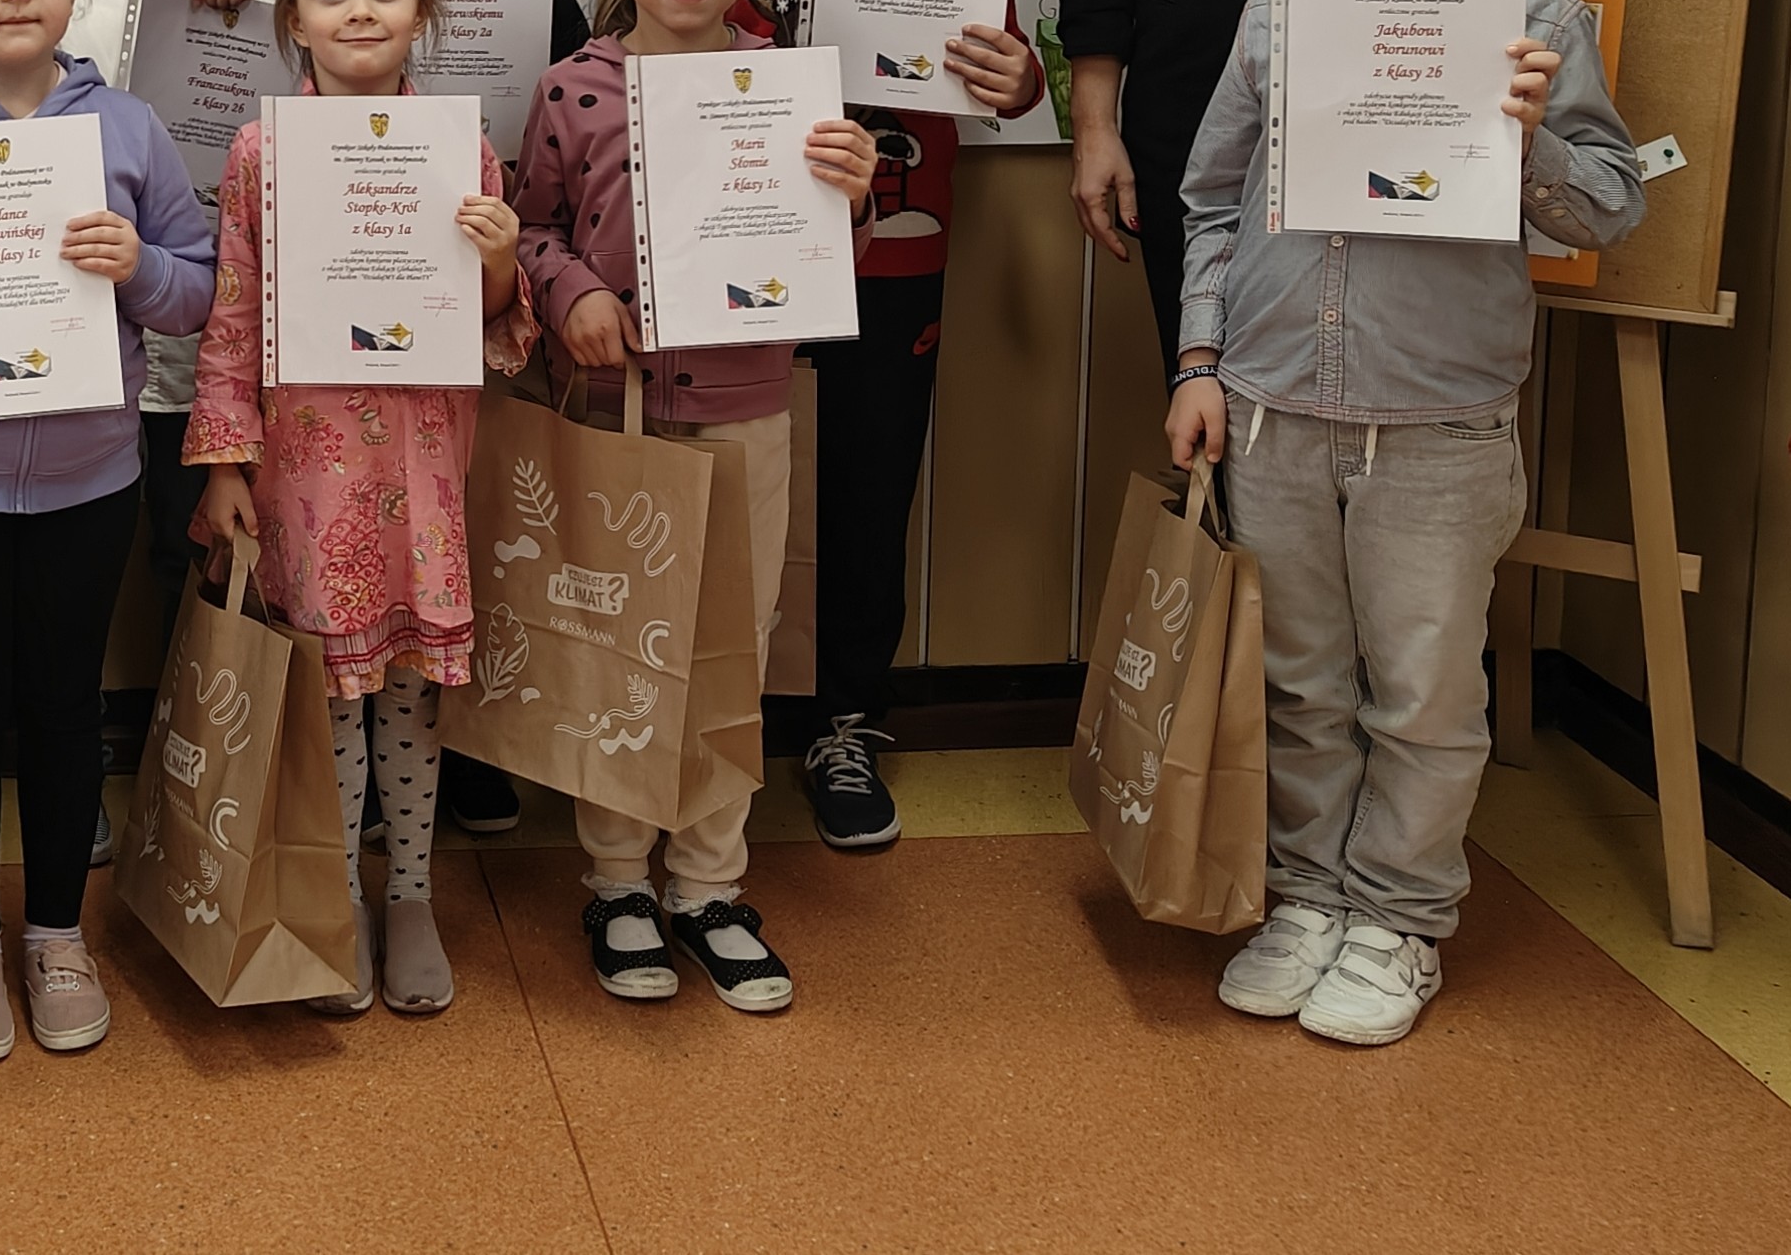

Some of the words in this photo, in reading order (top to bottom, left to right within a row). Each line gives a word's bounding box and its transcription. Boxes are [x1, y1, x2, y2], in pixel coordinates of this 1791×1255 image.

[450, 26, 478, 40] klasy
[480, 27, 492, 37] 2a
[1374, 23, 1444, 39] Jakubowi
[1372, 43, 1447, 55] Piorunowi
[200, 63, 250, 81] Karolowi
[1387, 64, 1422, 82] klasy
[187, 77, 257, 98] Franczukowi
[202, 97, 230, 114] klasy
[343, 183, 418, 196] Aleksandrze
[734, 179, 764, 193] klasy
[767, 178, 781, 190] 1c
[344, 201, 421, 215] Stopko-Król
[364, 223, 395, 238] klasy
[397, 223, 412, 235] 1a
[27, 247, 41, 259] 1c
